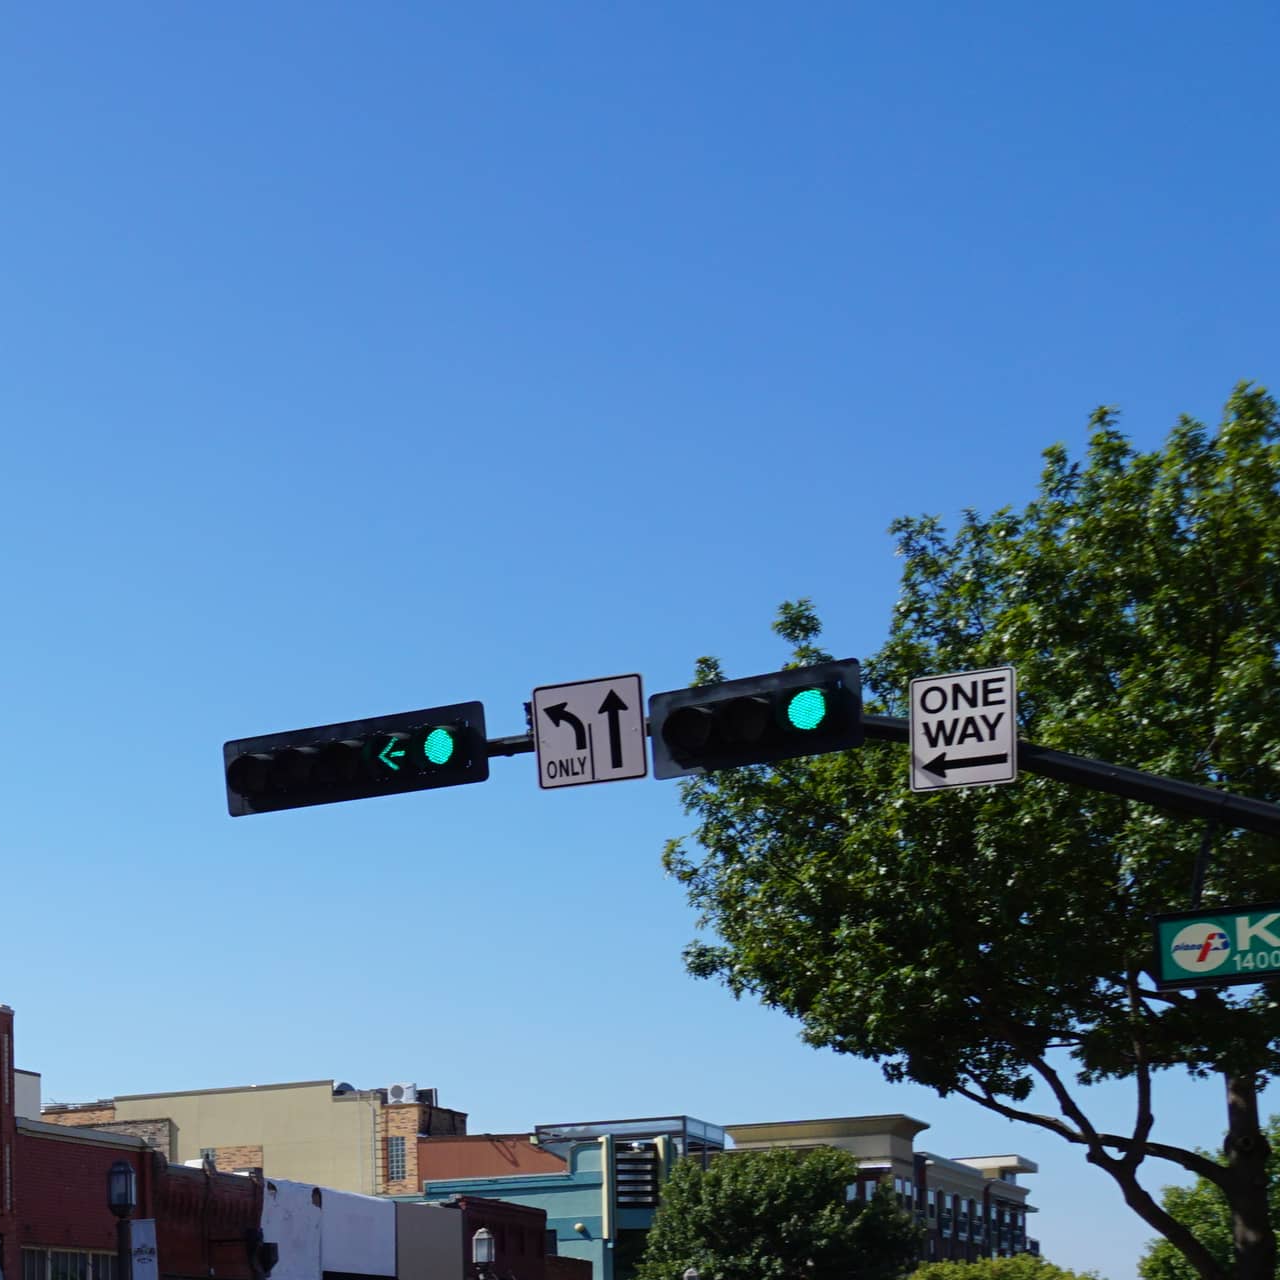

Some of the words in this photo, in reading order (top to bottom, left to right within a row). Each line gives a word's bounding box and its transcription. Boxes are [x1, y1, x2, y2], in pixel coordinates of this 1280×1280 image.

[920, 677, 1006, 714] ONE
[922, 712, 1005, 748] WAY
[546, 756, 587, 780] ONLY
